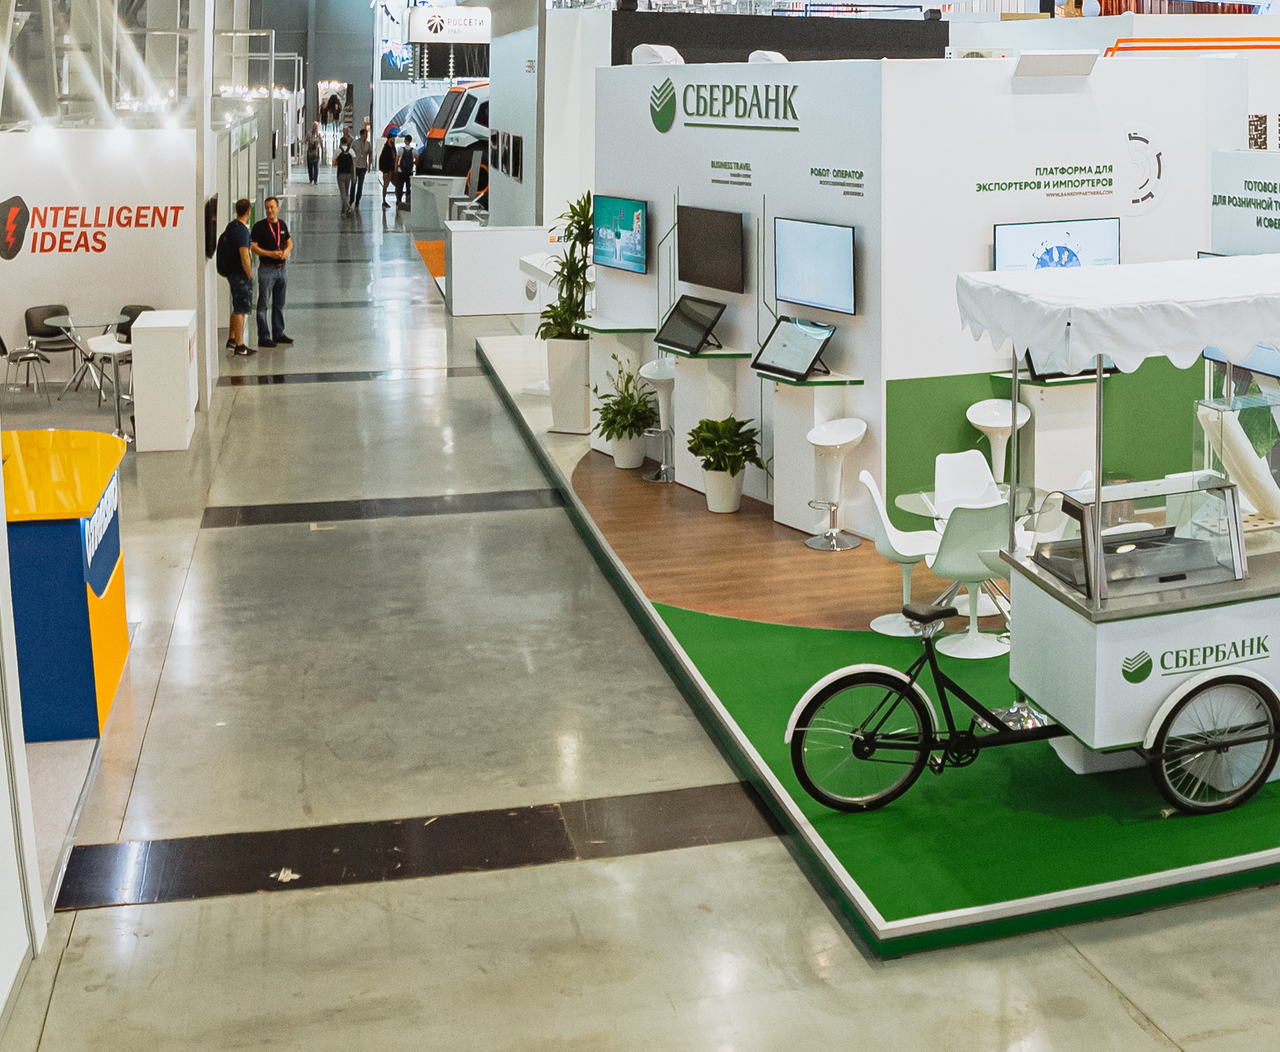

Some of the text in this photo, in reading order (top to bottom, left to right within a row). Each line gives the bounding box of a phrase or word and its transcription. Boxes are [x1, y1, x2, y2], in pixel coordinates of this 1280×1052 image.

[447, 18, 484, 27] РОССЕТИ
[682, 84, 799, 121] СБЕРБАНК
[711, 160, 733, 170] BUSINESS
[1035, 164, 1113, 176] ПЛАТФОРМА ДЛЯ
[832, 169, 864, 180] ОПЕРАТОР
[975, 178, 1113, 192] ЭКСПОРТЕРОВ И ИМПОРТЕРОВ
[1243, 179, 1278, 194] ГОТОВОЕ
[1211, 194, 1226, 206] ДЛЯ
[1227, 195, 1273, 210] РОЗНИЧНОЙ
[30, 206, 185, 229] NTELLIGENT
[1256, 216, 1262, 227] И
[30, 231, 107, 254] IDEAS
[1160, 635, 1270, 670] СБЕРБАНК
